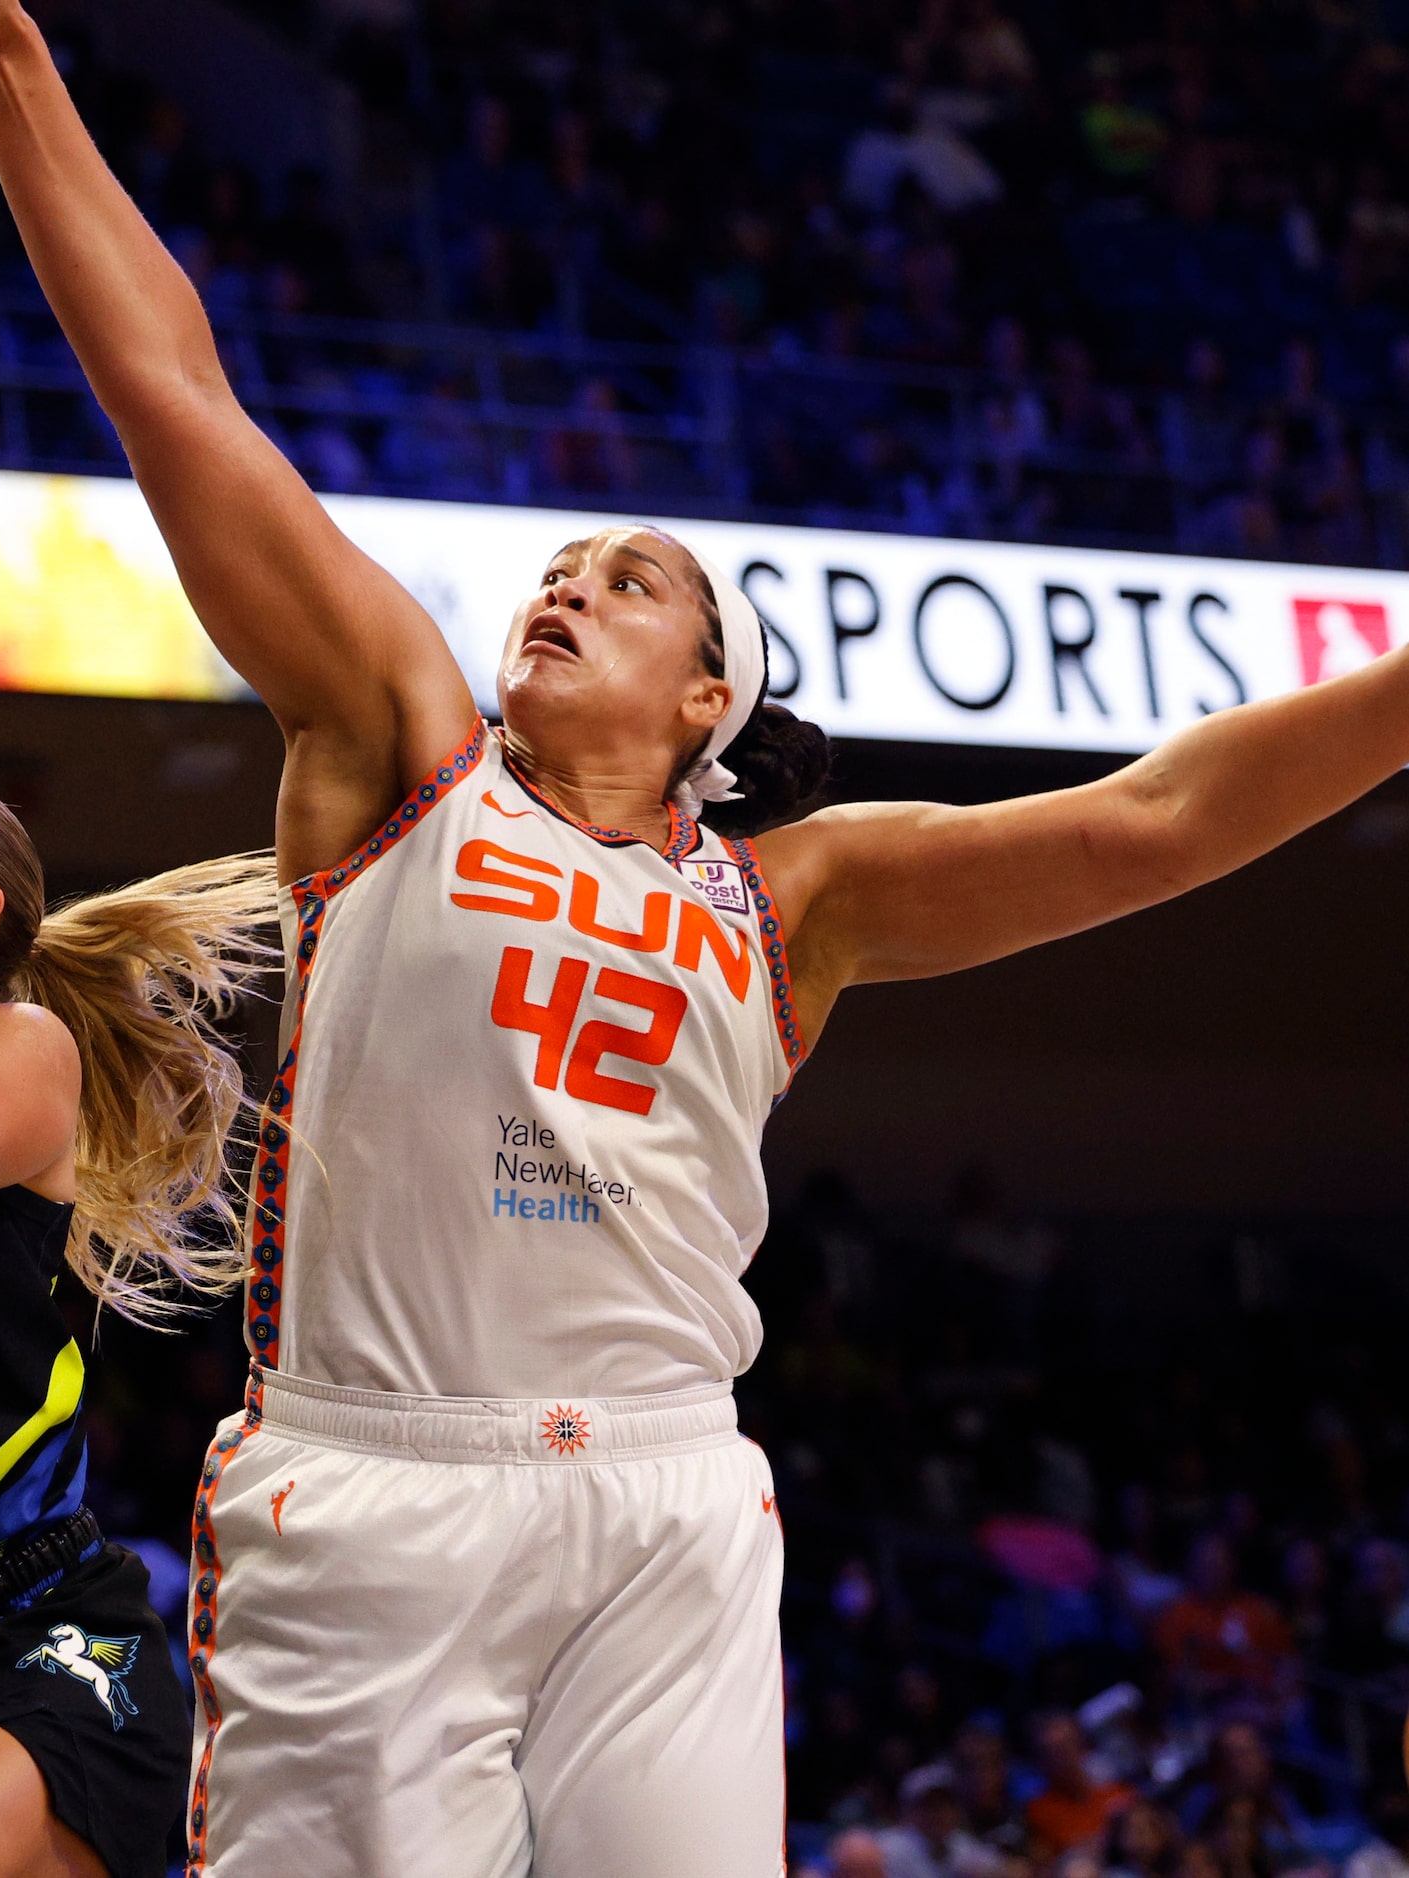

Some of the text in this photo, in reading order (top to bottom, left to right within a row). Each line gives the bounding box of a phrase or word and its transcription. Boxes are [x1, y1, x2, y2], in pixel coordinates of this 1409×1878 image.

[741, 561, 1248, 719] SPORTS
[450, 838, 752, 1005] SUN
[490, 946, 688, 1117] 42
[493, 1188, 600, 1223] Health
[497, 1114, 555, 1149] Yale
